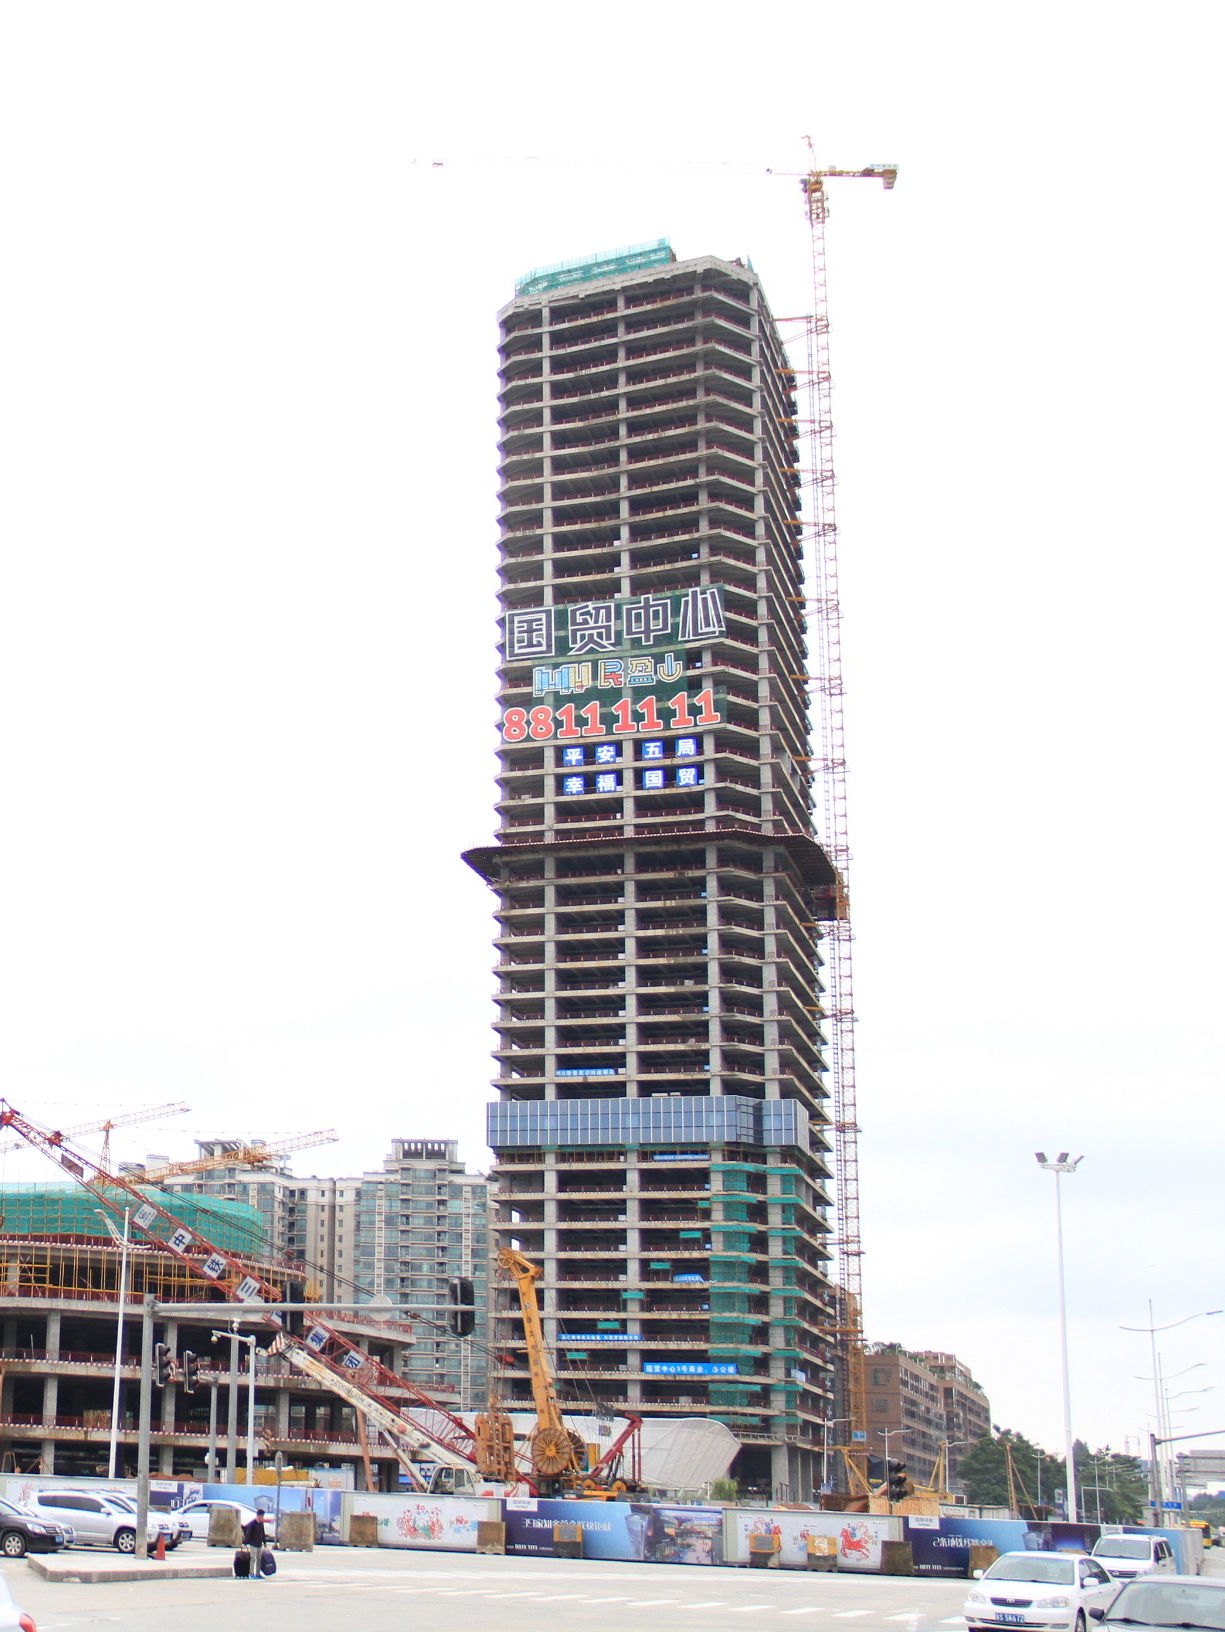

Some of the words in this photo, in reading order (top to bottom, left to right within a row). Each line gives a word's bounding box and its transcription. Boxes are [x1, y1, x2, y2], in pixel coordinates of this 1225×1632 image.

[506, 587, 726, 661] 国贸中心
[597, 653, 683, 689] 民盈山
